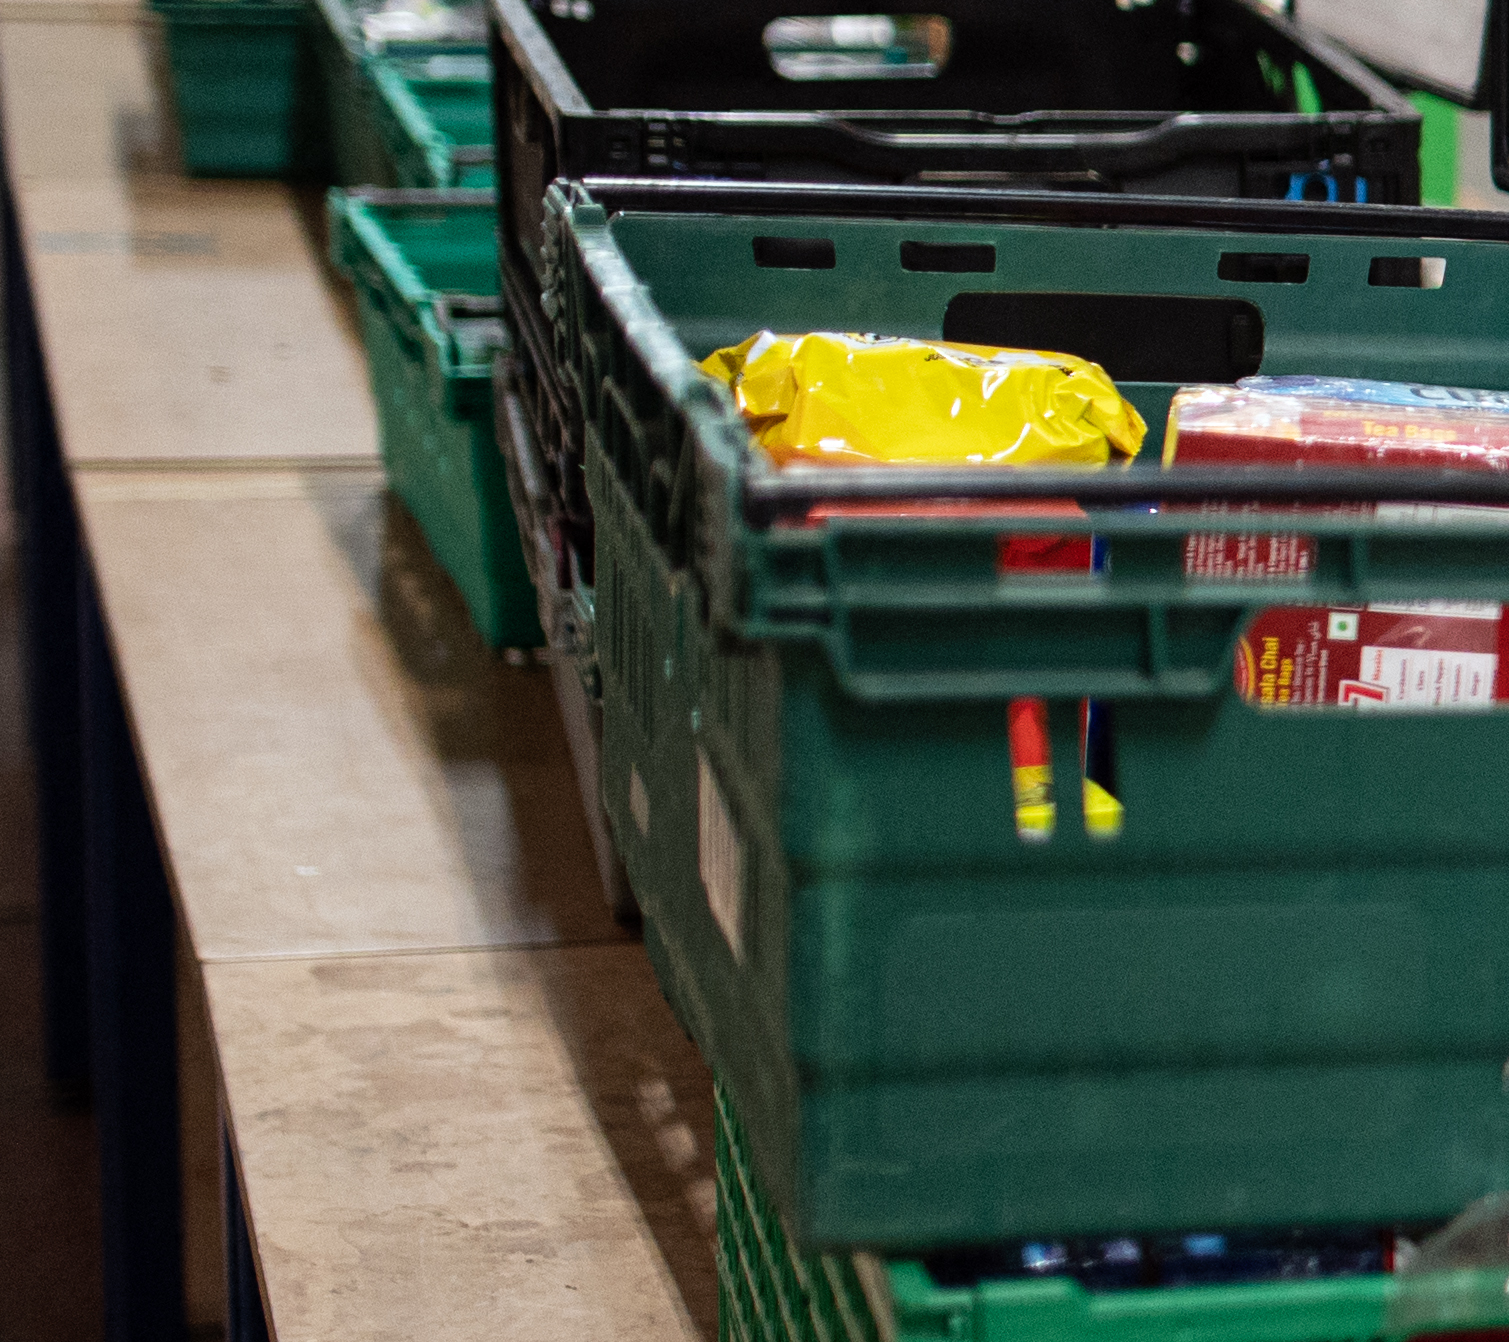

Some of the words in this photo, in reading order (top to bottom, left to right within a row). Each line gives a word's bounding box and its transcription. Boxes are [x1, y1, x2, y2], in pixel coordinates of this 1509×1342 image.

[1363, 420, 1399, 439] Tea
[1405, 423, 1457, 443] Bags
[1259, 636, 1280, 670] Chai
